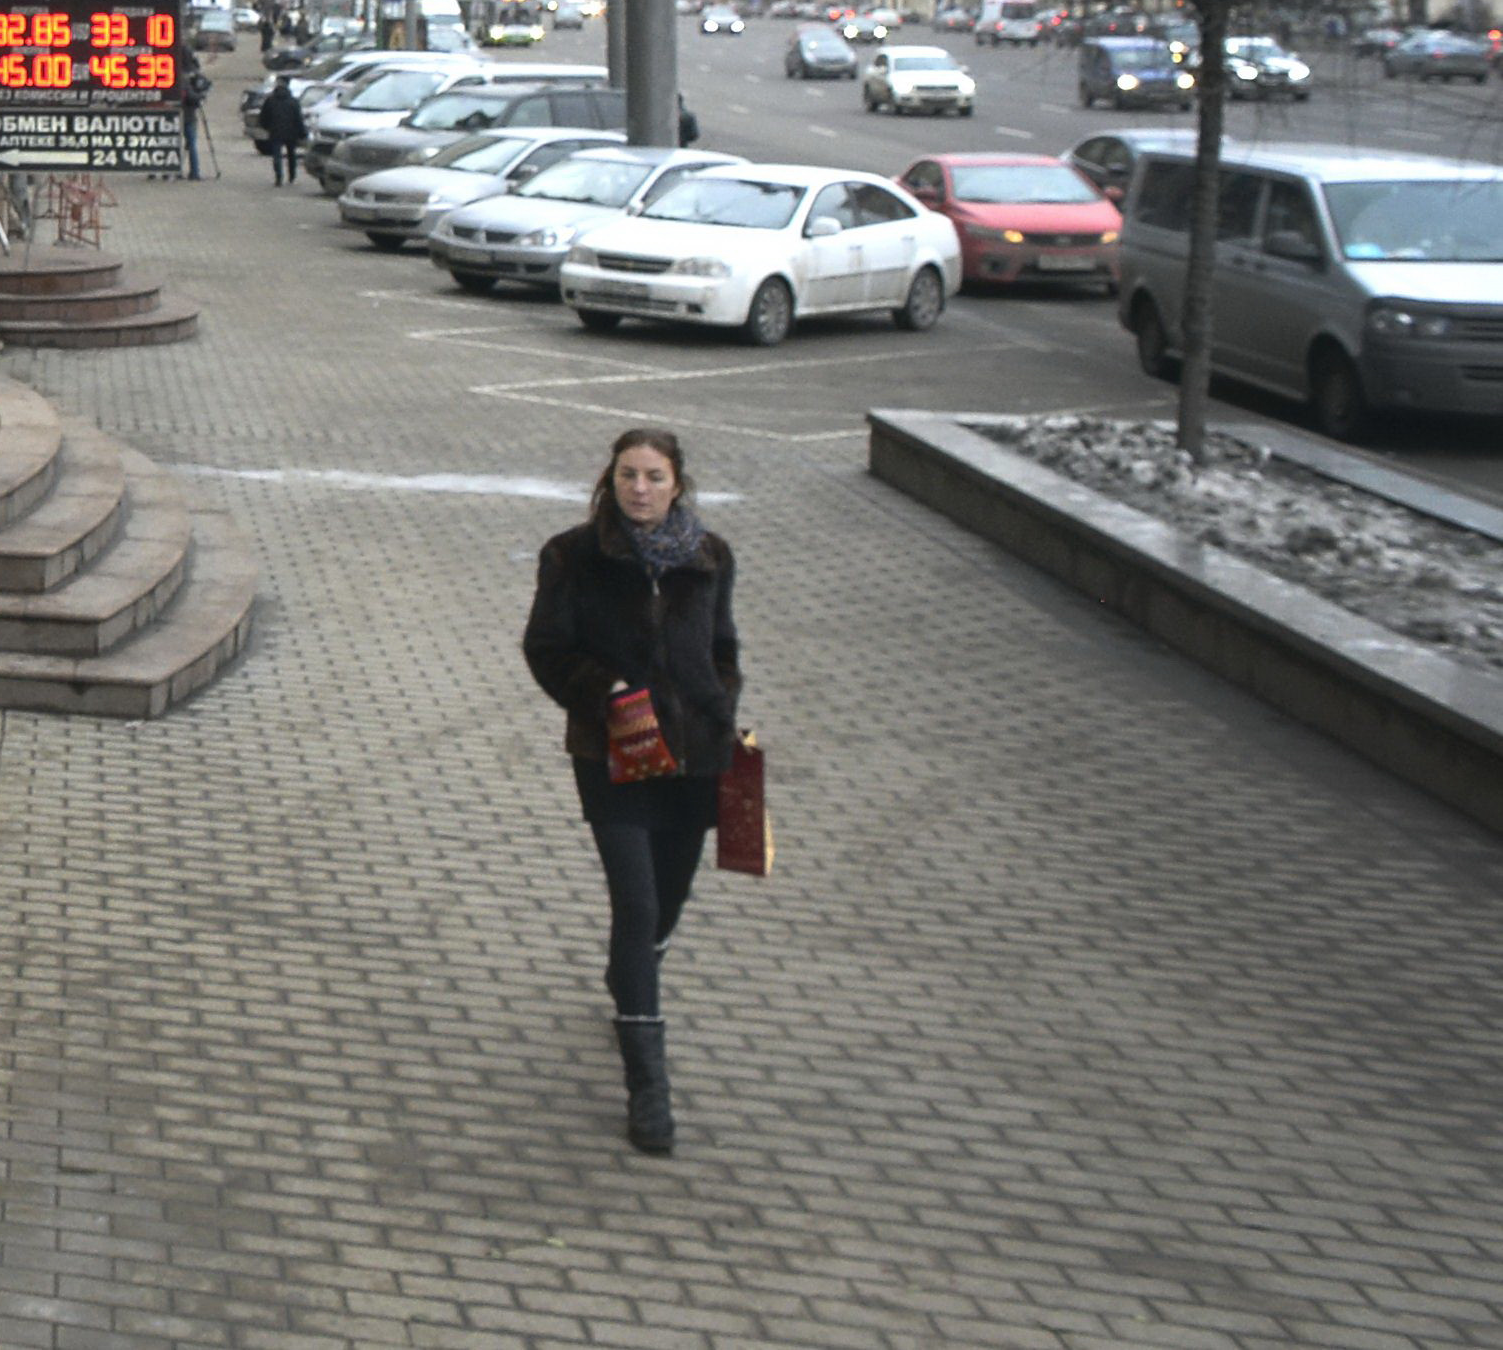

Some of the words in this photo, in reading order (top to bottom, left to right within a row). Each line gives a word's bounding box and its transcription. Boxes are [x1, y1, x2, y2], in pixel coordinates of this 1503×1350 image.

[88, 53, 175, 88] 45.39
[72, 115, 180, 134] ВАЛЮТЫ
[0, 135, 56, 147] АПТЕКЕ
[92, 135, 114, 147] НА
[115, 136, 126, 147] 2
[128, 136, 180, 148] ЭТАЖЕ
[92, 151, 118, 165] 24
[122, 151, 181, 166] ЧАСА
